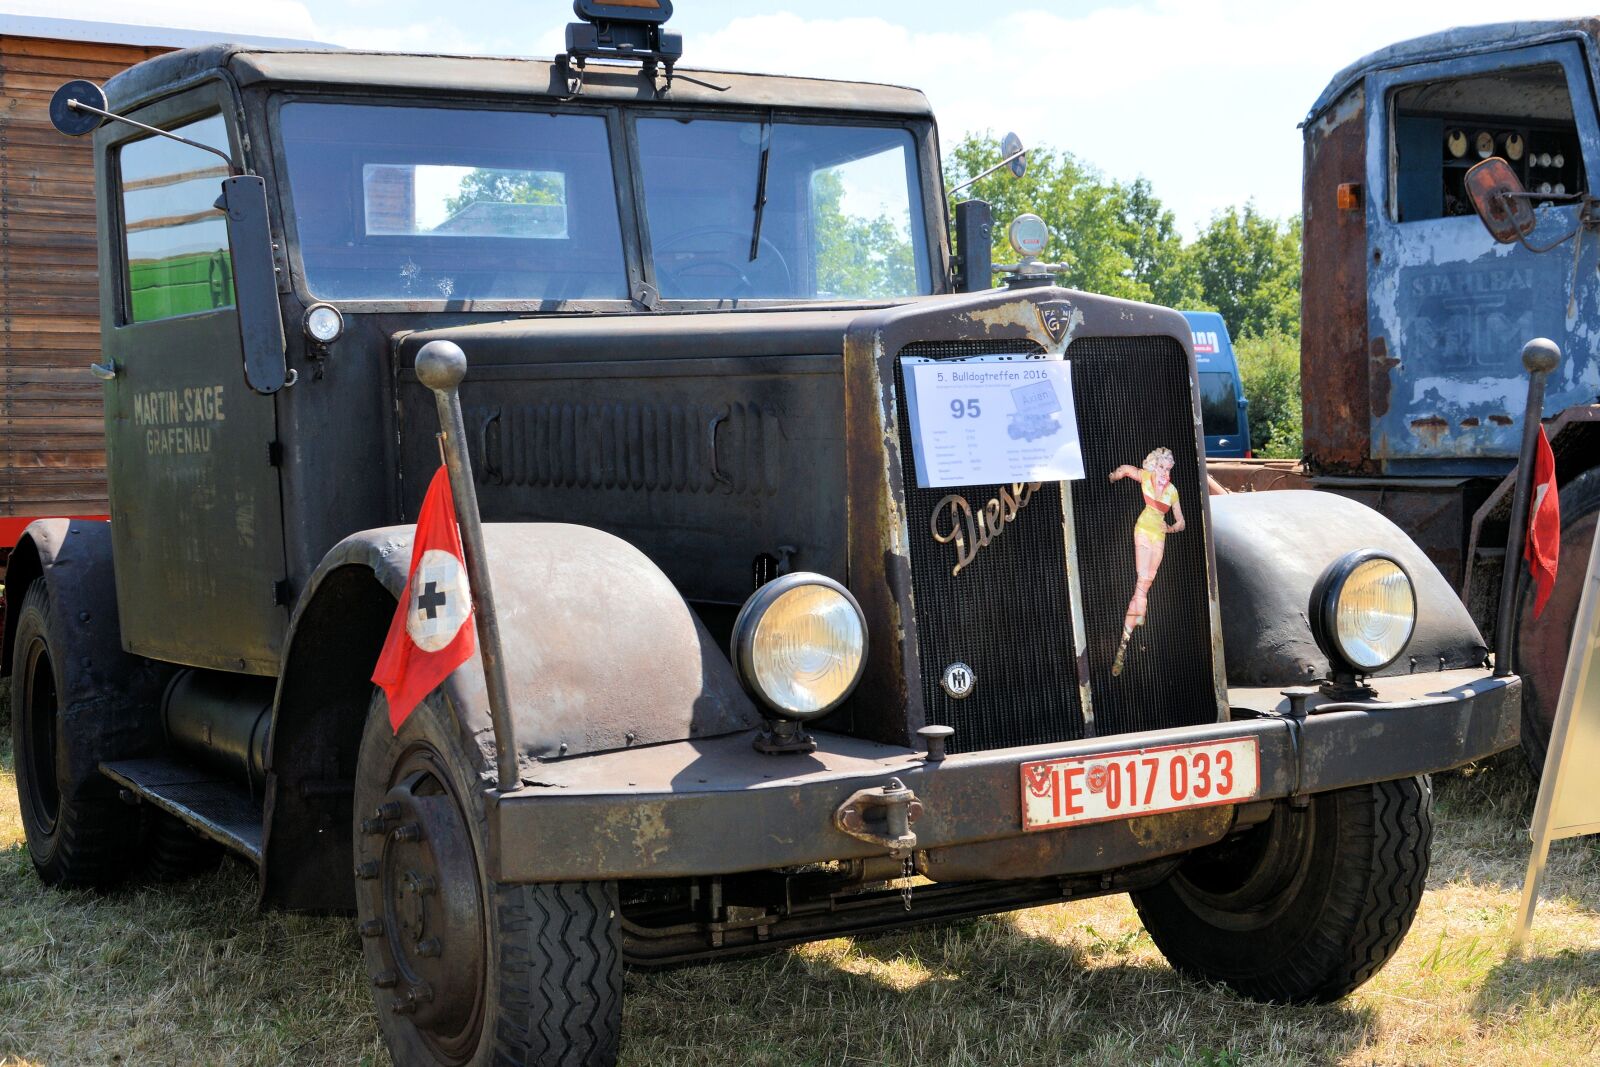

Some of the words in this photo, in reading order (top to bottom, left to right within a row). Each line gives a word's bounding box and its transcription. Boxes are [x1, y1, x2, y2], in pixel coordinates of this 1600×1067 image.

[937, 372, 948, 382] 5.
[952, 371, 1020, 384] Bulldogtreffen
[1023, 370, 1048, 380] 2016
[134, 385, 225, 425] MARTIN-SÄGE
[950, 398, 982, 419] 95
[146, 428, 210, 455] GRAFENAU
[931, 481, 1041, 577] Diese
[1105, 757, 1160, 810] 017
[1169, 749, 1234, 801] 033
